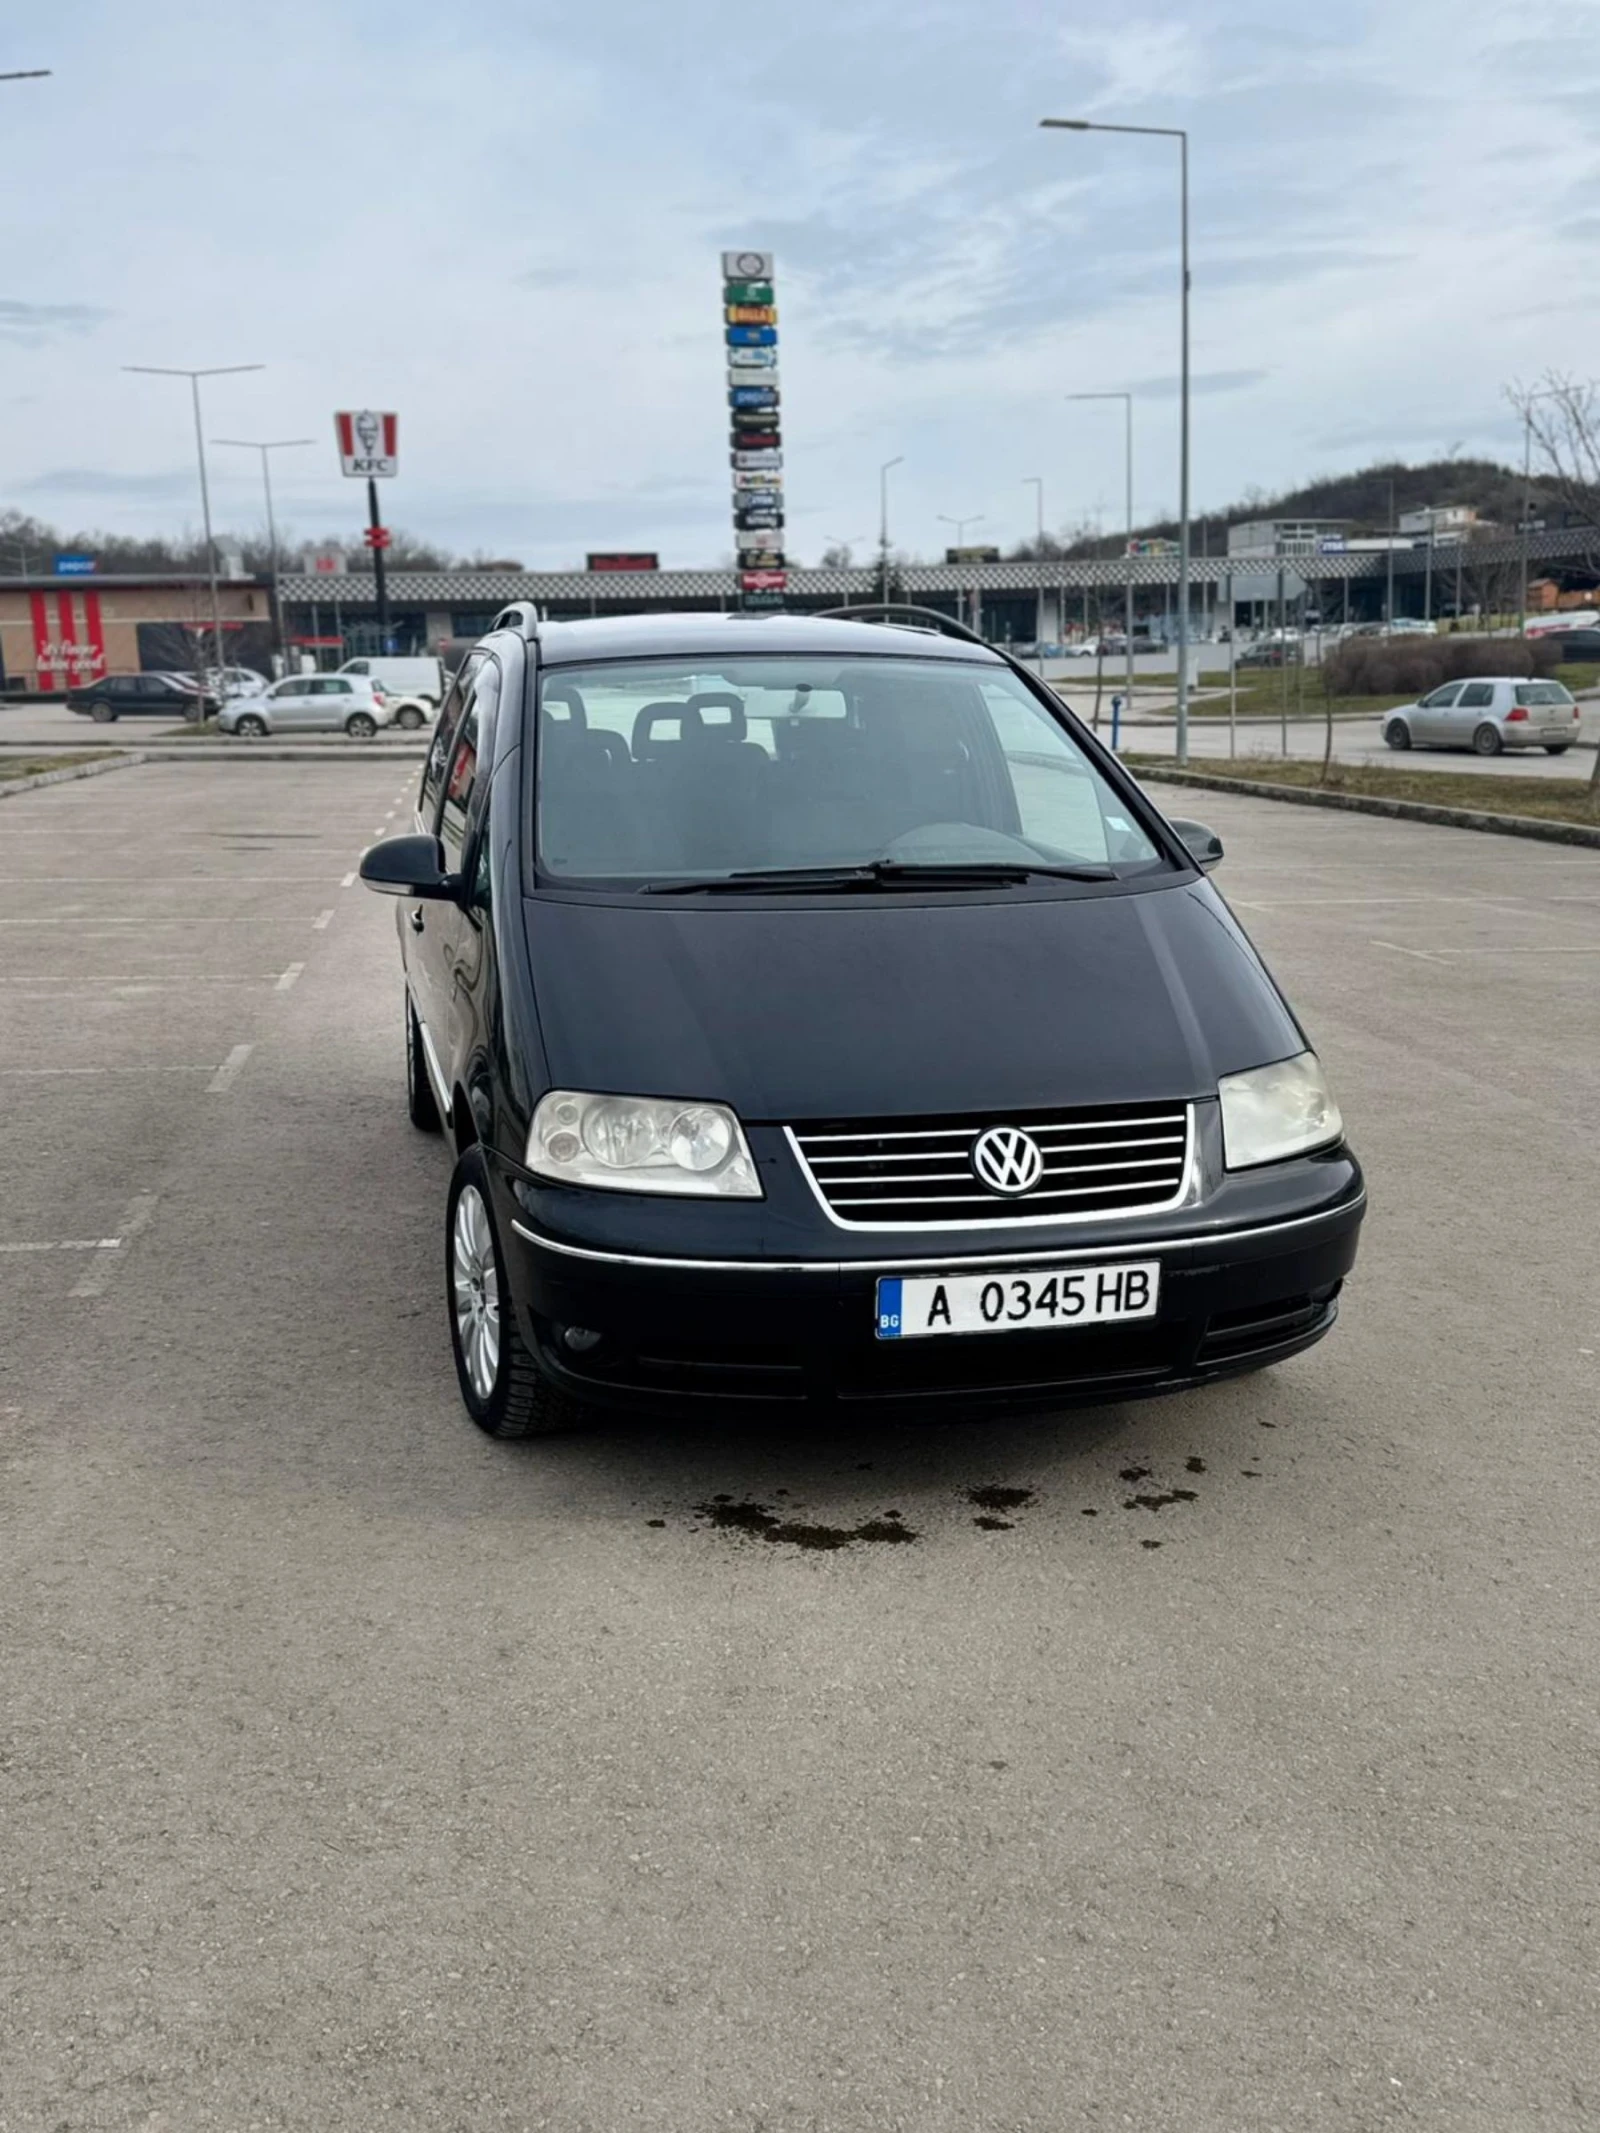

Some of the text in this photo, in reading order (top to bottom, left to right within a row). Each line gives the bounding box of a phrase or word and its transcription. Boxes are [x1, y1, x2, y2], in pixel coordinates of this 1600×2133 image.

[353, 458, 388, 471] KFC
[59, 561, 96, 573] pepco
[71, 654, 105, 675] good
[927, 1269, 1151, 1327] A 0345 HB
[879, 1314, 899, 1328] BG
